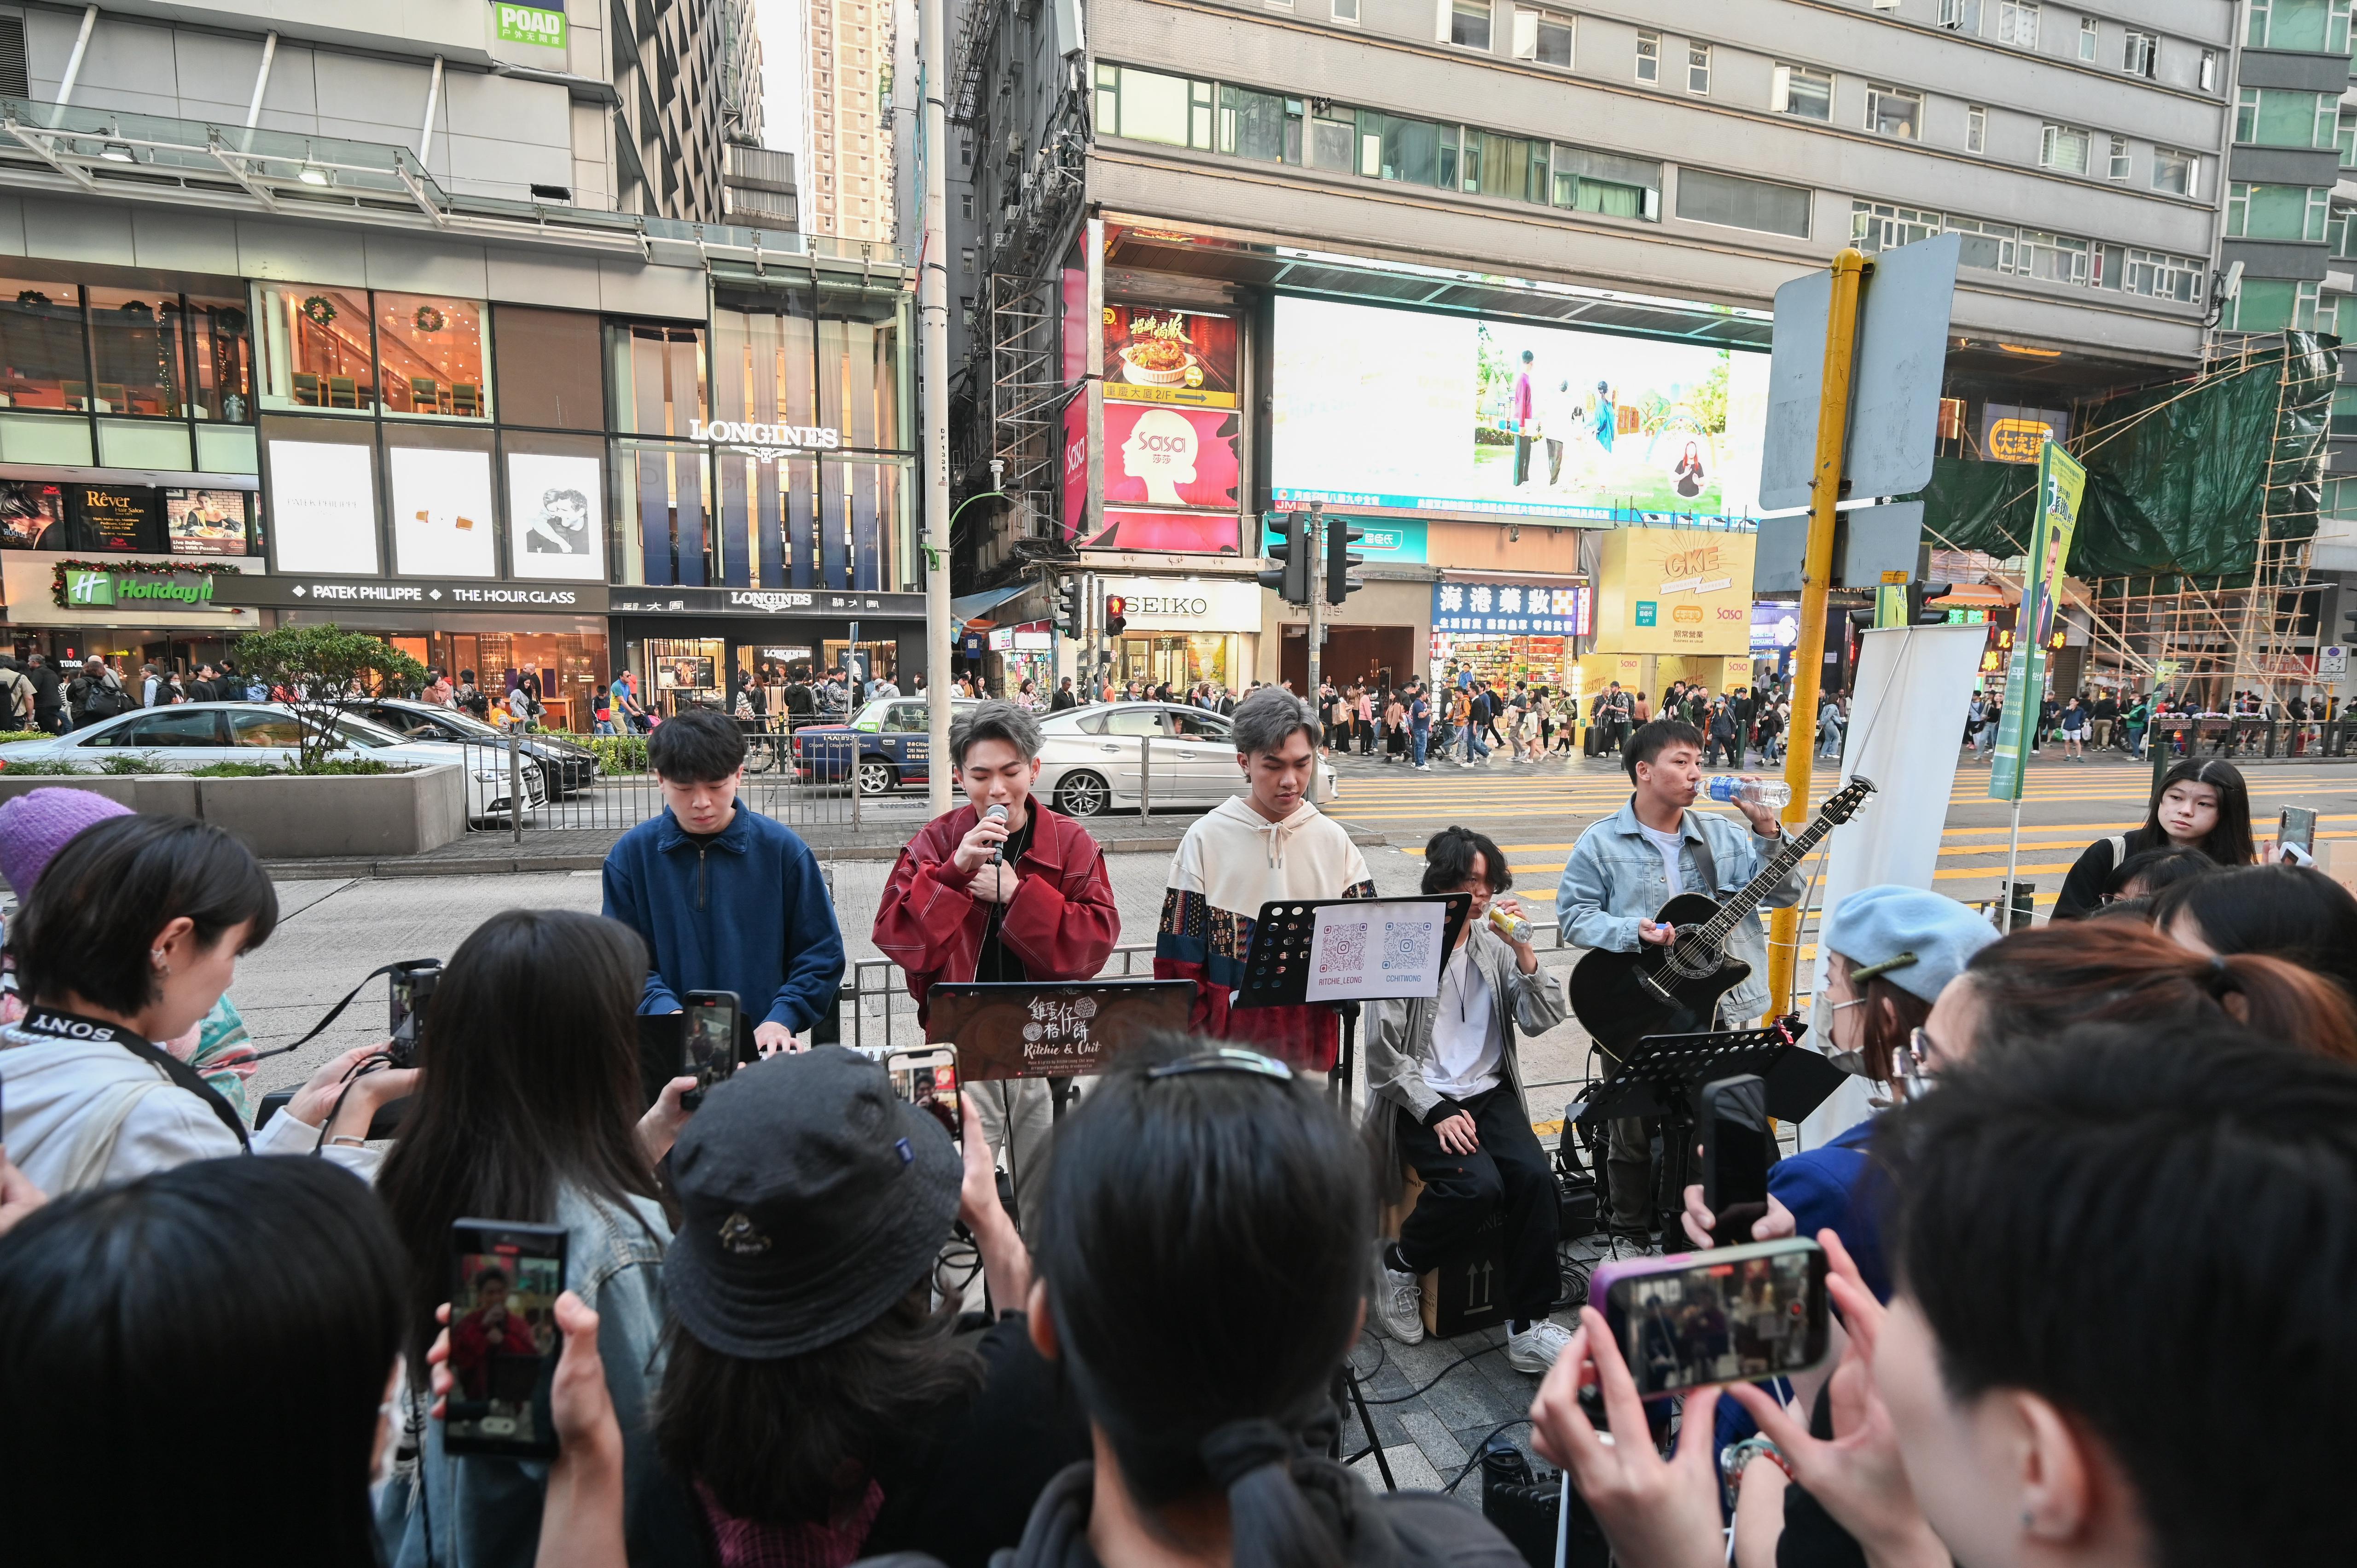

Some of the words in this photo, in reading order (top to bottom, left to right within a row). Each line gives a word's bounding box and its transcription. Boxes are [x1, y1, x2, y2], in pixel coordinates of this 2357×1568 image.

[501, 7, 559, 35] POAD
[502, 29, 560, 45] 户外无限度
[1106, 385, 1153, 399] 重慶大廈
[1155, 389, 1172, 400] 2/F
[690, 419, 838, 449] LONGINES
[1152, 454, 1171, 464] 莎莎
[86, 491, 130, 508] Rêver
[1277, 501, 1296, 510] JM
[1364, 533, 1393, 545] 屈臣氏
[1665, 546, 1719, 578] CKE
[117, 579, 199, 603] Holiday
[1664, 580, 1697, 591] CHUNGKING
[1701, 581, 1725, 590] EXPRESS
[313, 585, 357, 599] PATEK
[360, 586, 422, 601] PHILIPPE
[453, 588, 482, 602] THE
[485, 589, 528, 603] HOUR
[529, 590, 576, 604] GLASS
[731, 592, 813, 606] LONGINES
[1440, 586, 1550, 614] 海港藥妝
[1122, 596, 1207, 616] SEIKO
[1674, 630, 1703, 639] 照常營業
[1318, 976, 1363, 986] RITCHIE_LEONG
[30, 1014, 115, 1042] SONY
[1023, 1043, 1060, 1059] Ritchie
[1064, 1043, 1074, 1054] &
[1077, 1040, 1102, 1055] Chit
